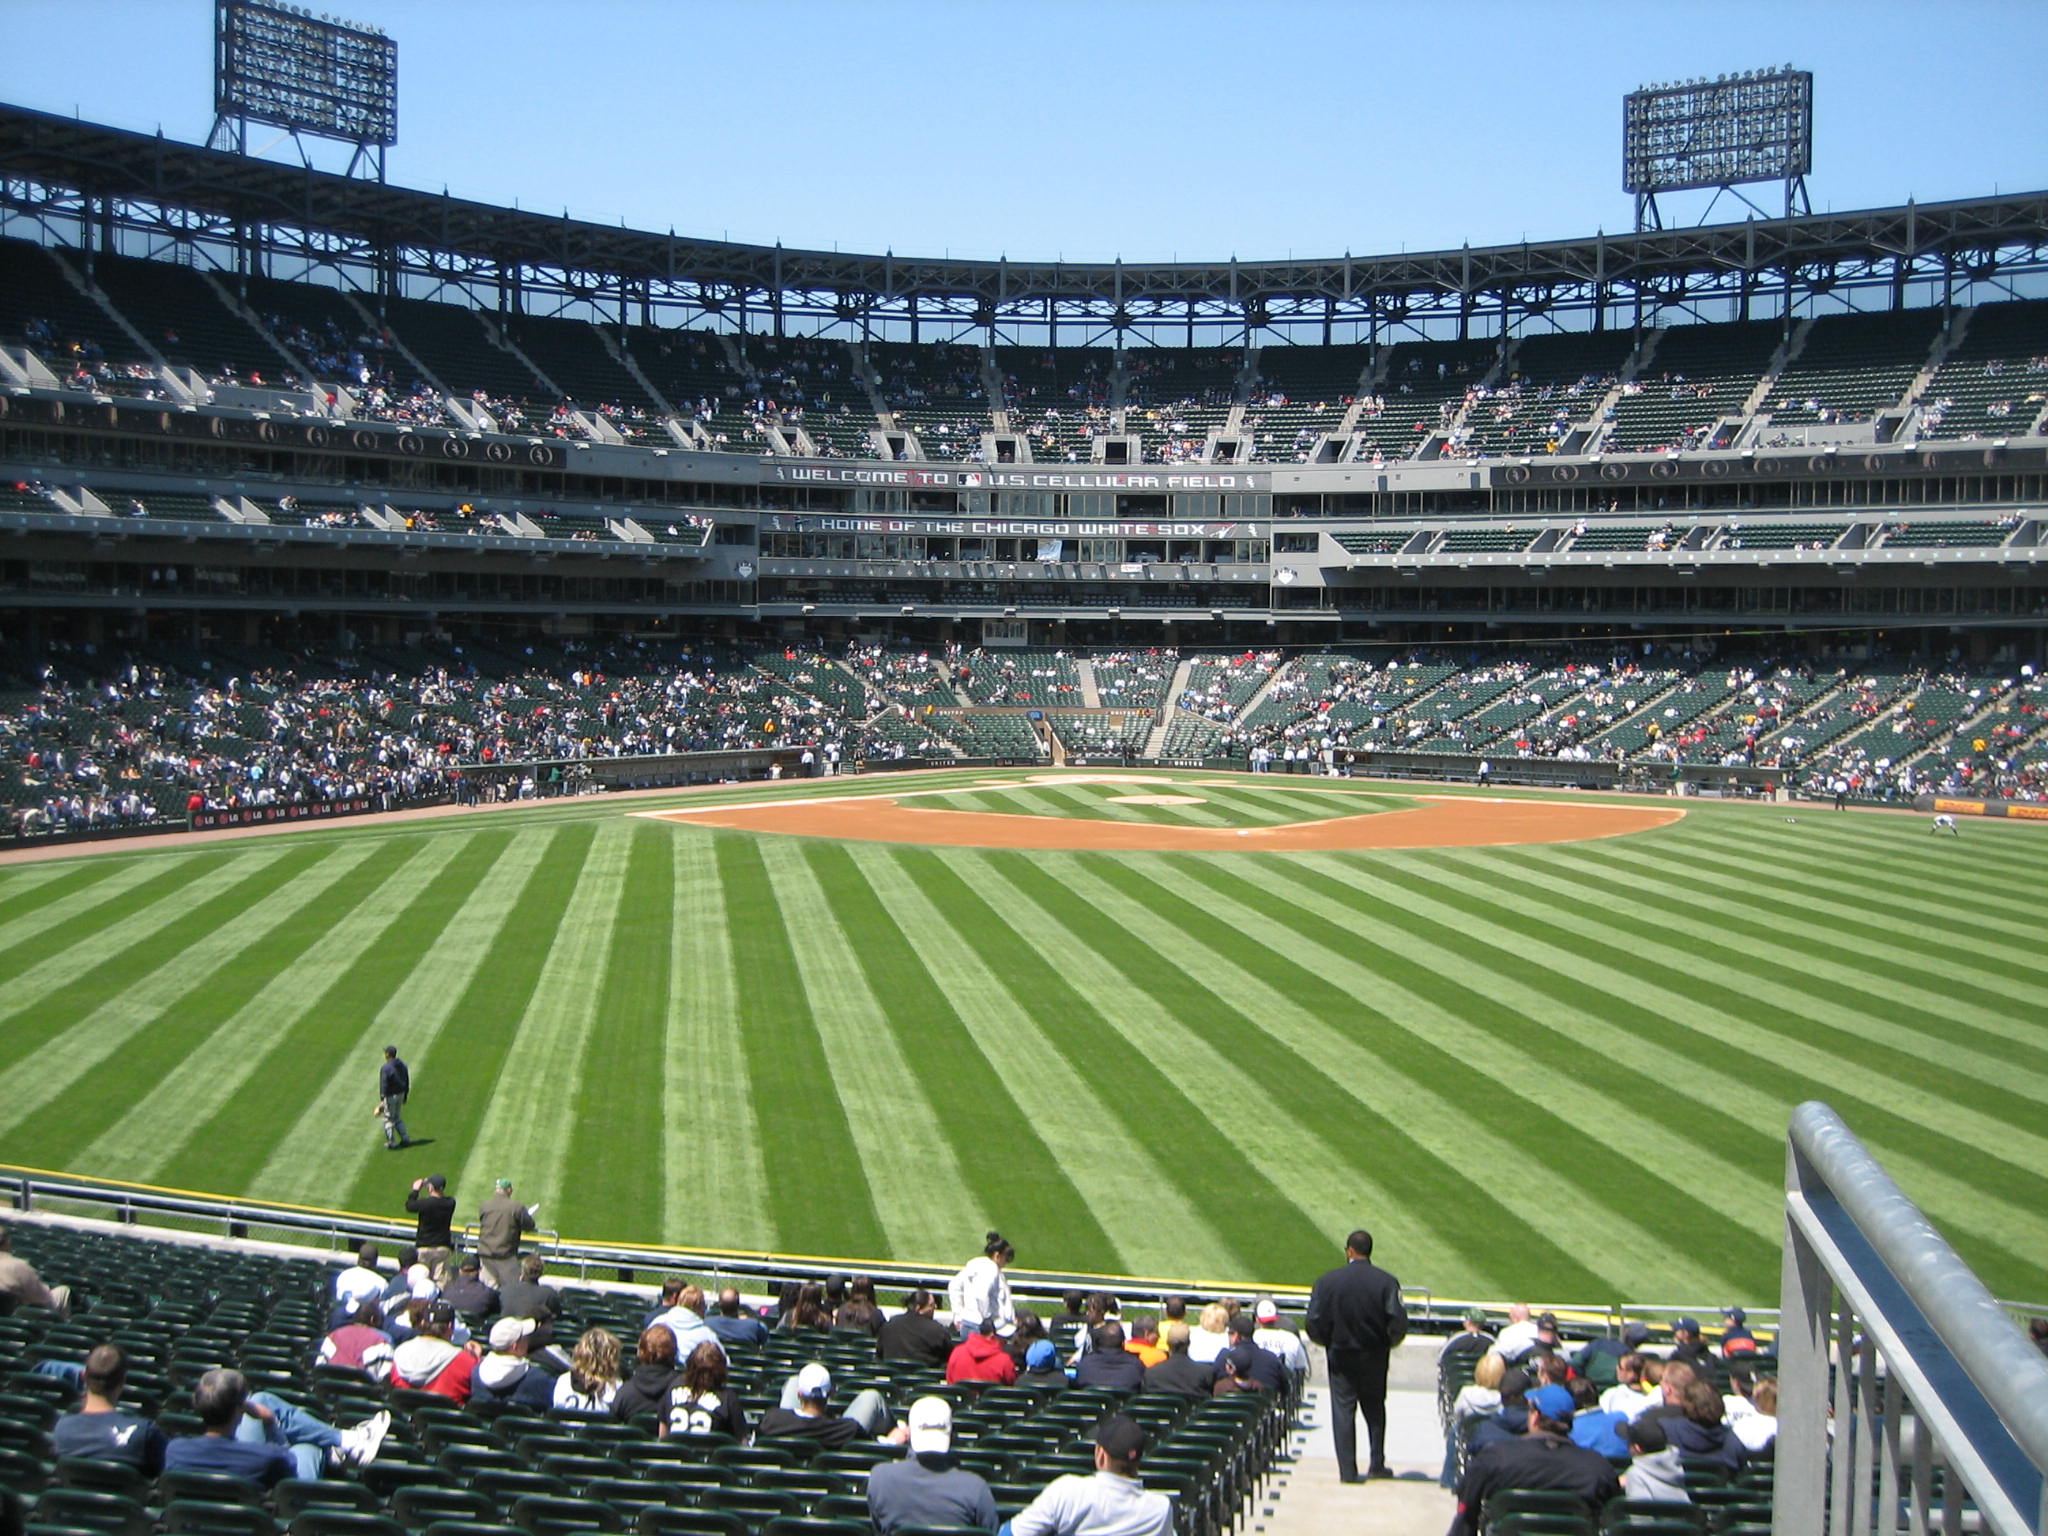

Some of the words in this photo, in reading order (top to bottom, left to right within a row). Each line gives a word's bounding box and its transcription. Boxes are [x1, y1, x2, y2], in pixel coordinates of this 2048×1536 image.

[792, 468, 908, 484] WELCOME
[917, 472, 949, 485] TO
[989, 474, 1028, 487] U.S.
[1033, 475, 1159, 488] CELLULAR
[1168, 476, 1235, 488] FIELD
[821, 518, 882, 532] HOME
[889, 520, 917, 532] OF
[923, 521, 964, 533] THE
[972, 522, 1069, 534] CHICAGO
[1079, 523, 1149, 535] WHITE
[1157, 524, 1206, 535] SOX
[322, 805, 330, 813] LG
[342, 803, 350, 811] LG
[361, 801, 369, 809] LG
[253, 811, 262, 819] LG
[276, 809, 285, 817] LG
[300, 807, 308, 815] LG
[205, 816, 214, 824] LG
[229, 814, 239, 822] LG
